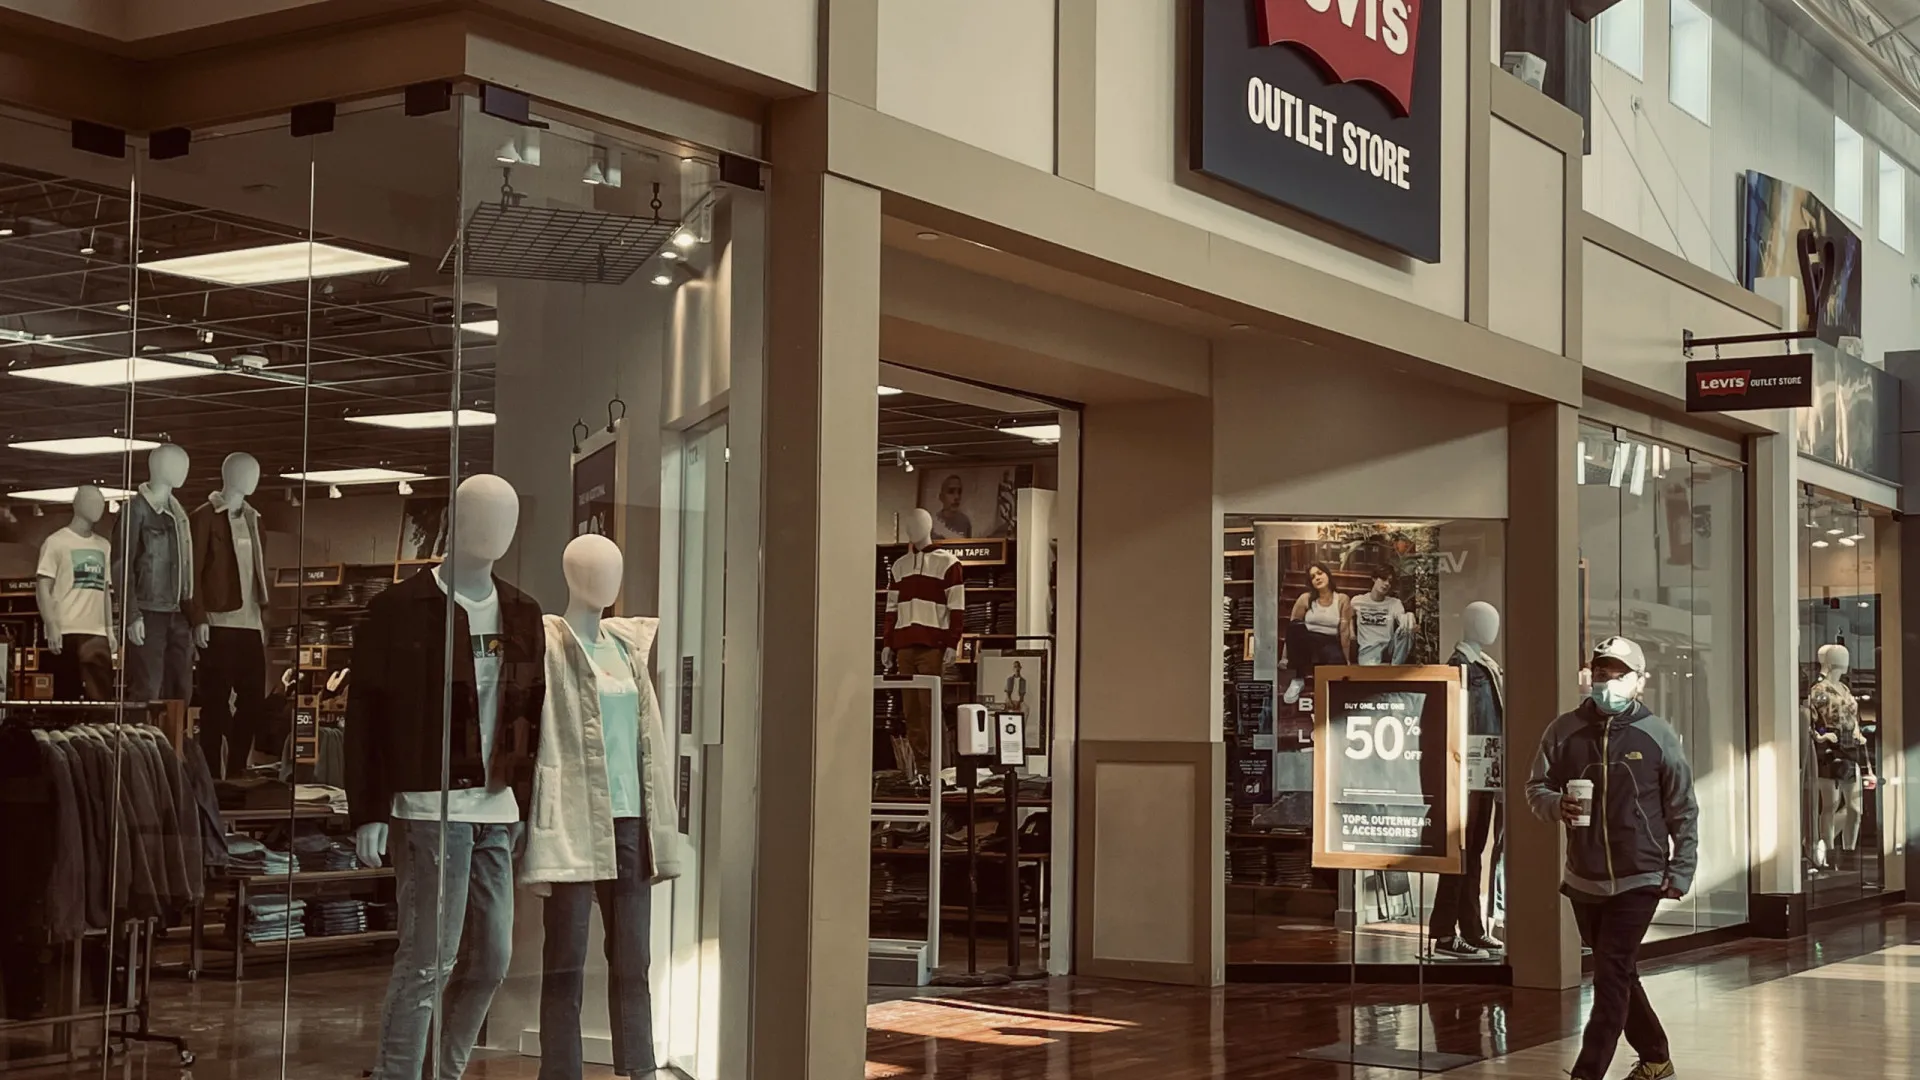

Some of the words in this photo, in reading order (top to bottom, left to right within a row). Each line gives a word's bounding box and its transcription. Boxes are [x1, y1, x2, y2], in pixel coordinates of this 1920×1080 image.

[1247, 76, 1337, 156] OUTLET
[1342, 121, 1410, 190] STORE
[1750, 378, 1777, 387] OUTLET
[1778, 376, 1802, 386] STORE
[965, 548, 990, 557] TAPER
[1344, 702, 1358, 710] BUY
[1376, 702, 1390, 711] GET
[1390, 703, 1405, 711] ONE
[1345, 715, 1421, 761] 50%
[1403, 750, 1423, 761] OFF
[1342, 814, 1369, 825] TOPS,
[1371, 816, 1432, 827] OUTERWEAR
[1342, 825, 1350, 835] &
[1352, 826, 1418, 838] ACCESSORIES
